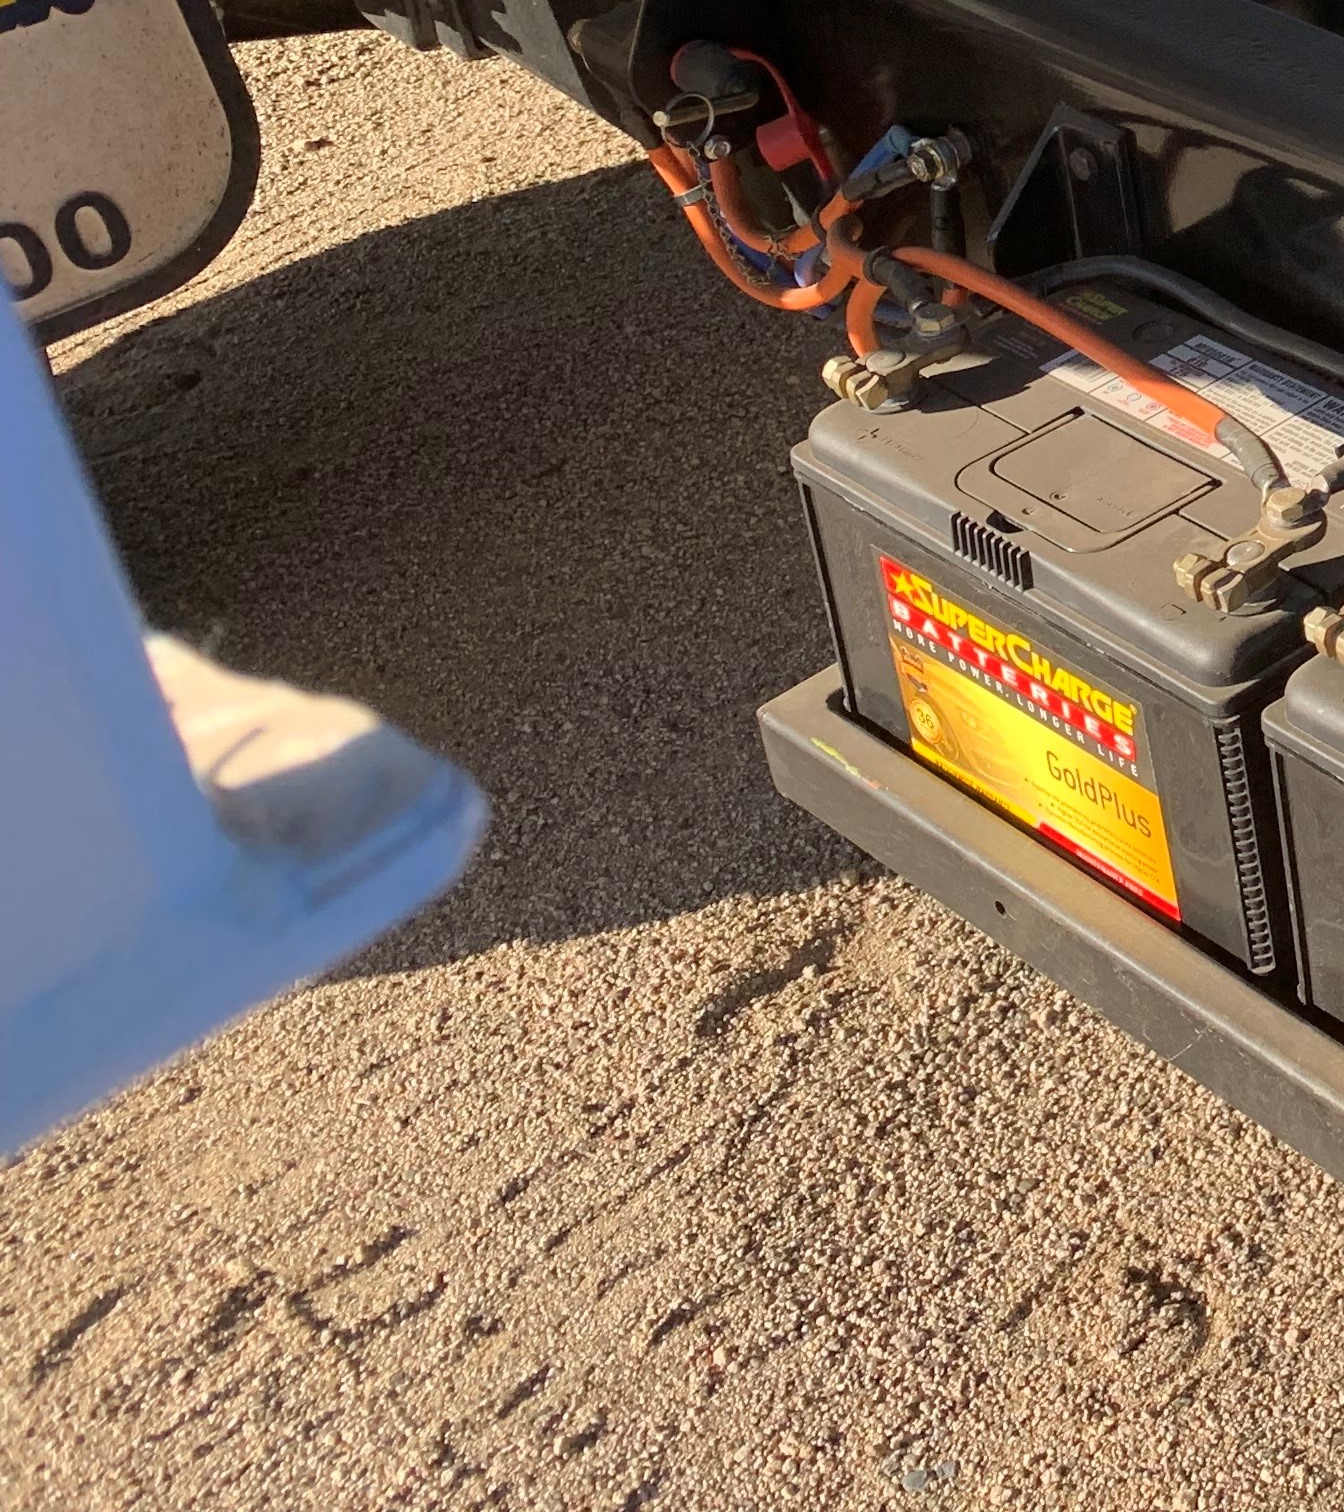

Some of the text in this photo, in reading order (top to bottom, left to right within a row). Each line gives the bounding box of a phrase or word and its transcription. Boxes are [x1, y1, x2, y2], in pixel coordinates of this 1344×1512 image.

[891, 599, 1133, 758] BATTERIES
[892, 617, 936, 654] MORE
[1016, 693, 1085, 745] LONGER
[1097, 742, 1139, 778] LIFE
[915, 706, 934, 730] 36
[1044, 748, 1152, 840] GoldPlus
